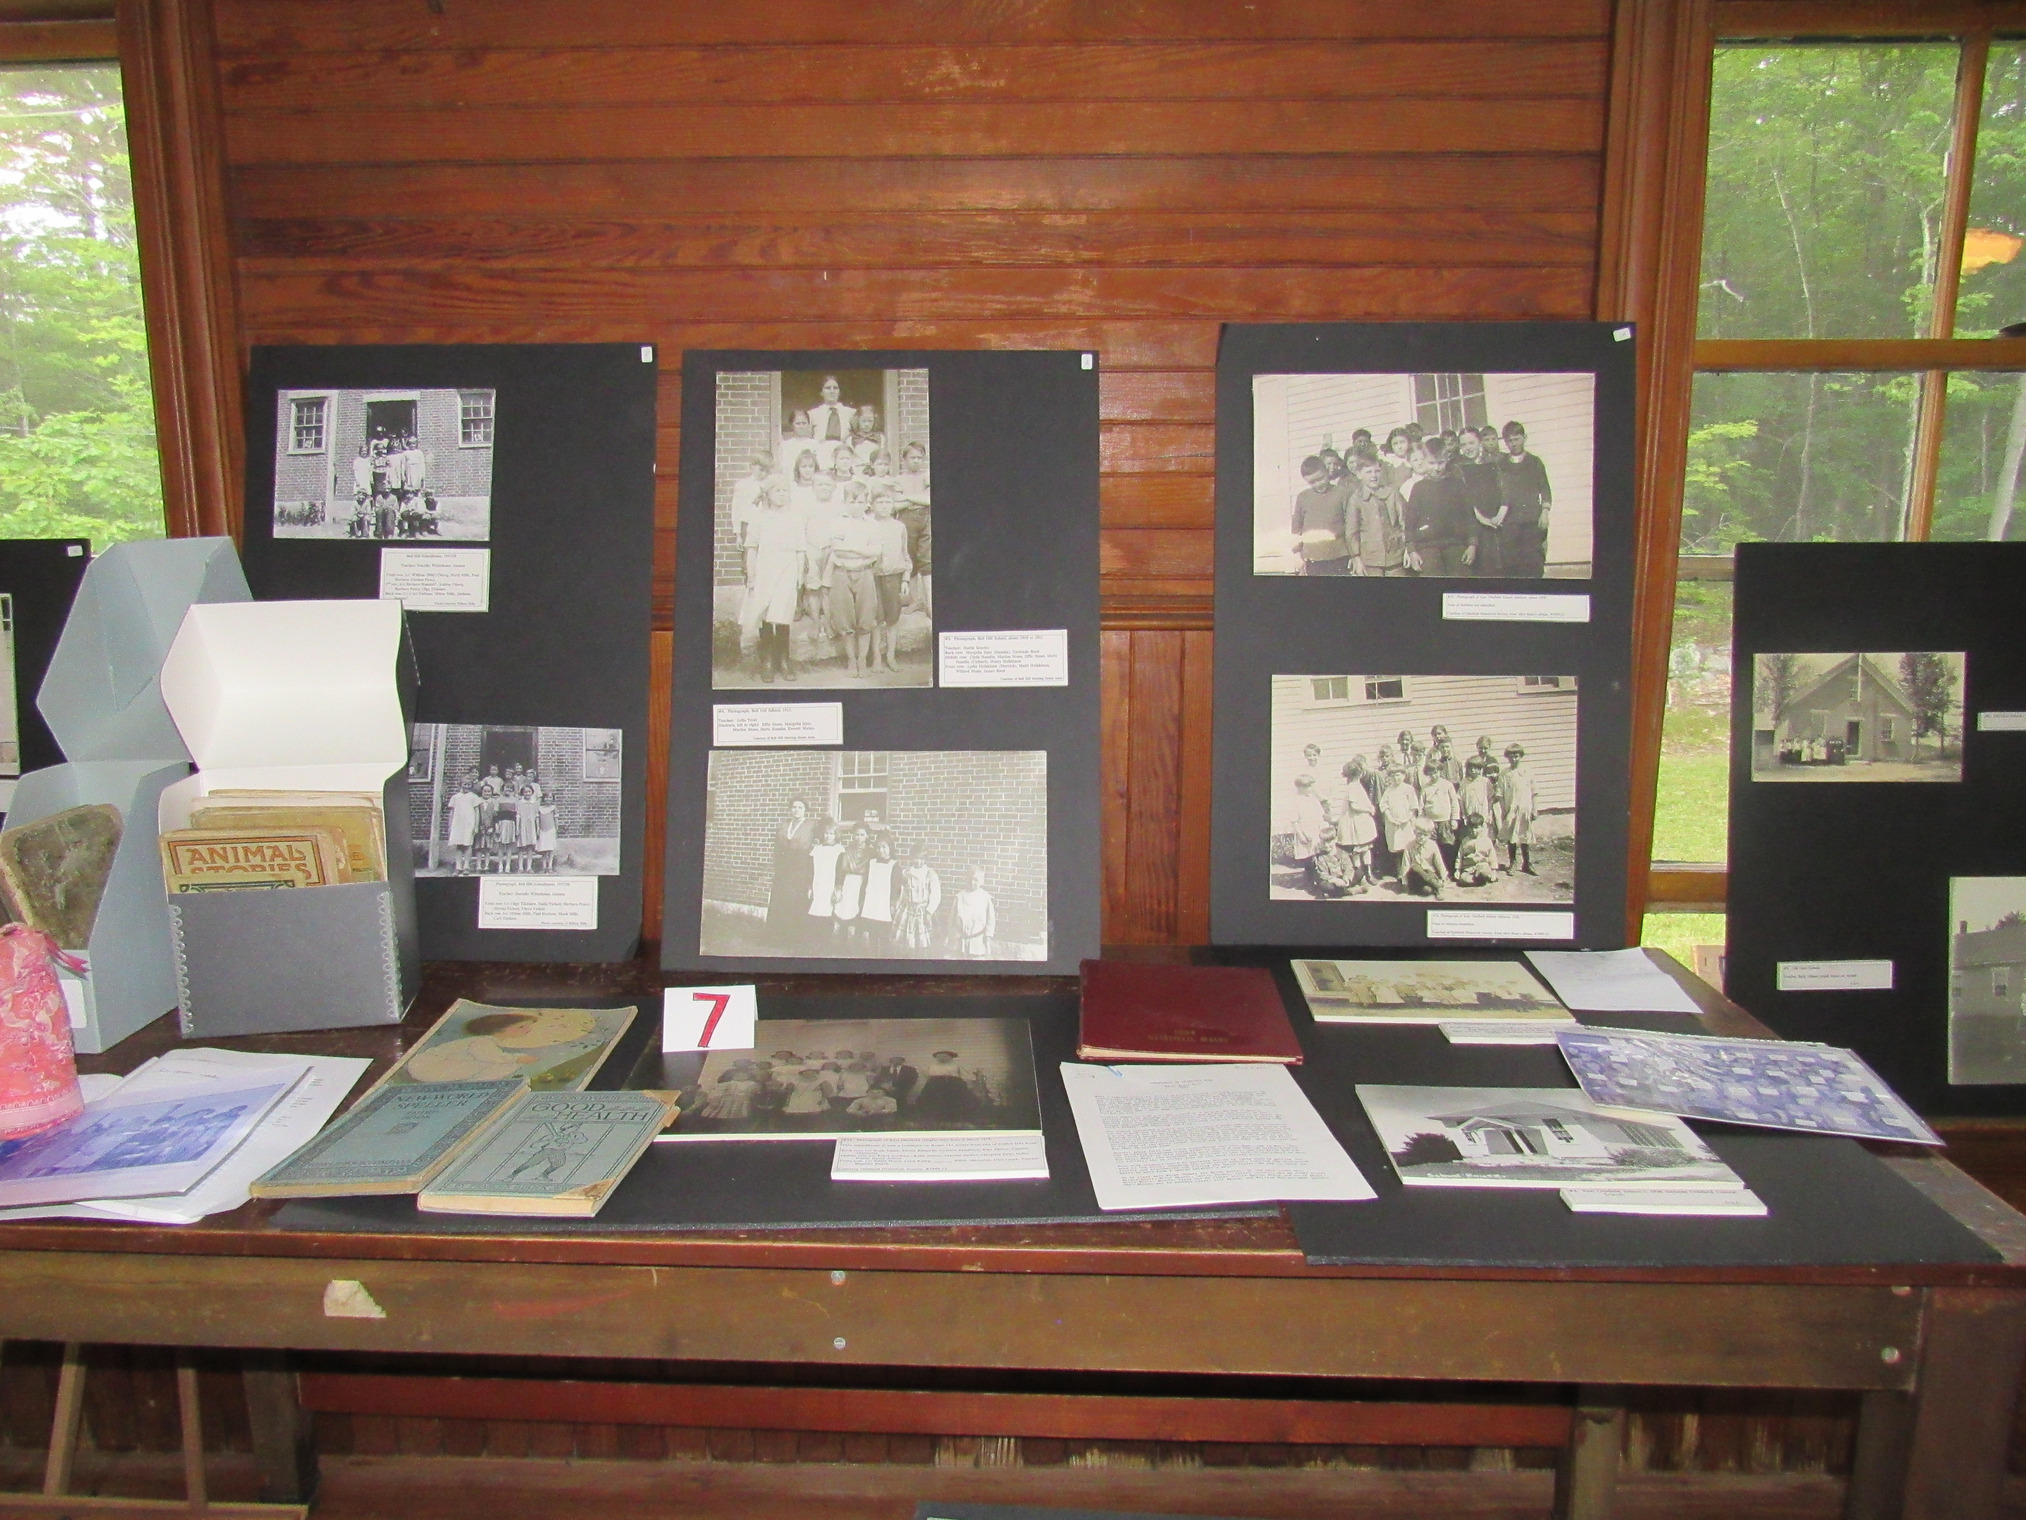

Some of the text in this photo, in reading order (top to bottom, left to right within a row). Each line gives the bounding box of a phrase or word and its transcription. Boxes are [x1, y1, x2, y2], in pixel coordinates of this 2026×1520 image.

[186, 844, 306, 865] ANIMAL
[692, 992, 731, 1048] 7
[531, 1102, 606, 1112] GOOD
[553, 1111, 650, 1121] HEALTH
